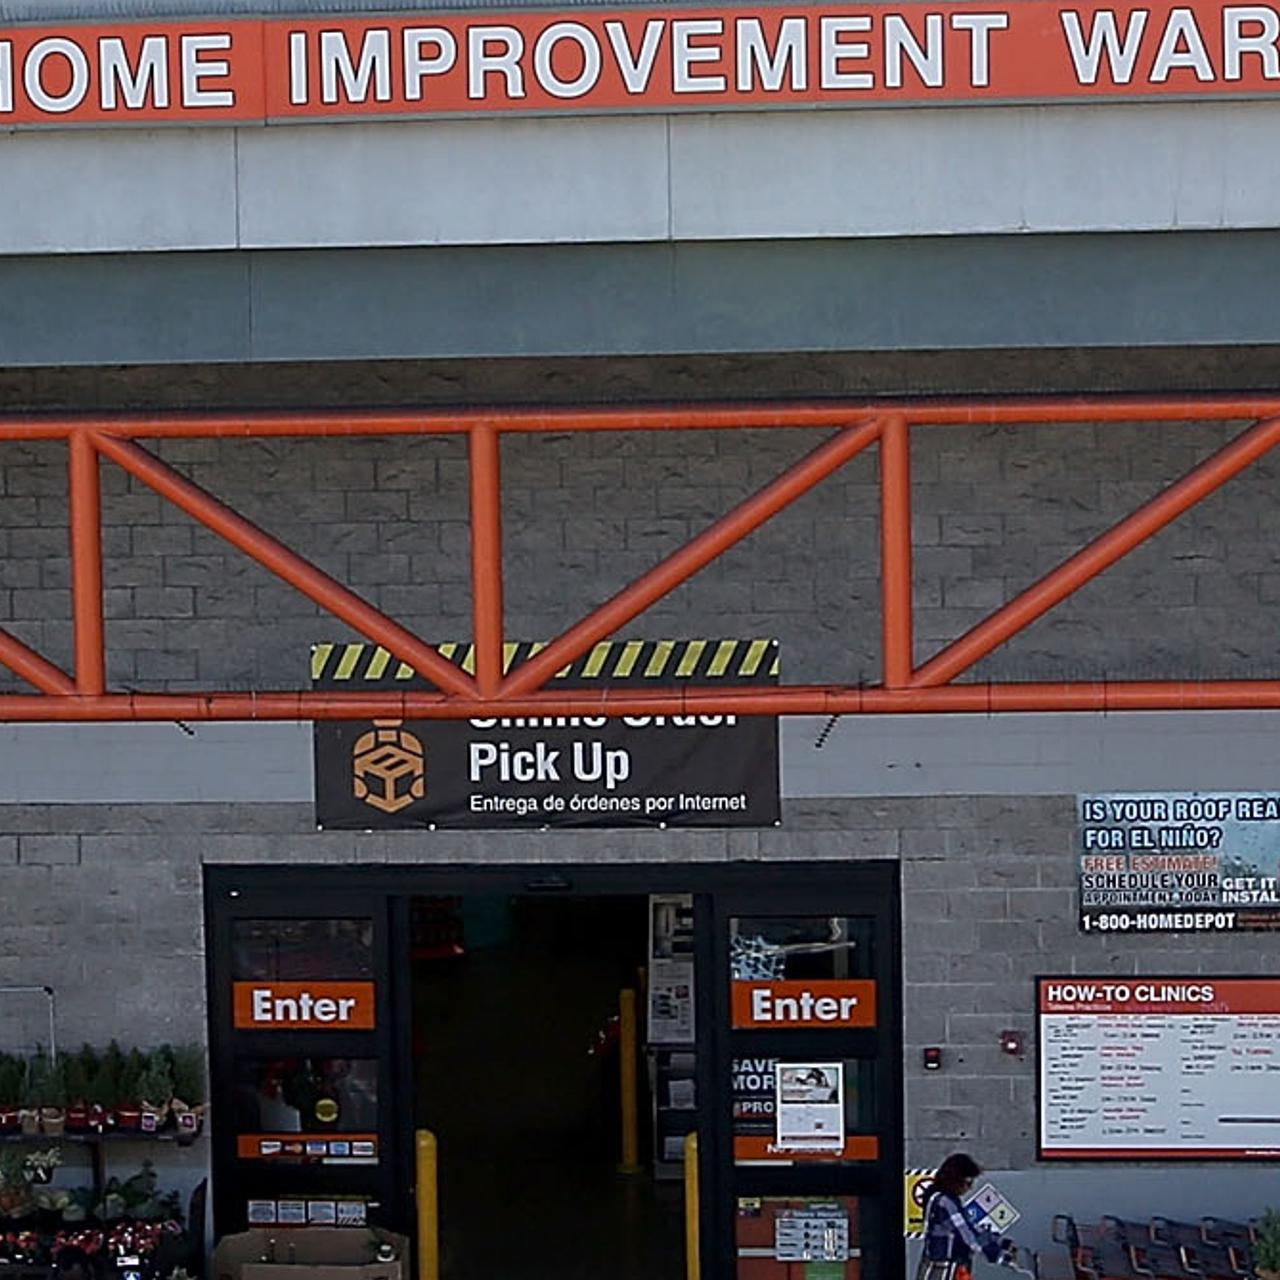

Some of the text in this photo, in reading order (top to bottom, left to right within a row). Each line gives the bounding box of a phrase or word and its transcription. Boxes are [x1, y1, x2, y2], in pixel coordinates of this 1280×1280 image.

[289, 14, 1008, 105] IMPROVEMENT
[469, 742, 630, 788] Pick Up
[471, 793, 746, 814] Entrega de órdenes por Internet
[1084, 800, 1105, 820] IS
[1113, 800, 1166, 820] YOUR
[1175, 800, 1230, 820] ROOF
[1086, 823, 1221, 847] FOR EL NIÑO?
[1084, 856, 1125, 871] FREE
[1084, 873, 1218, 889] SCHEDULE YOUR
[1222, 877, 1277, 890] GET IT
[1082, 912, 1236, 930] 1-800-HOMEDEPOT
[1047, 984, 1215, 1002] HOW-TO CLINICS
[253, 989, 356, 1022] Enter
[751, 989, 858, 1021] Enter
[731, 1074, 777, 1090] MOR
